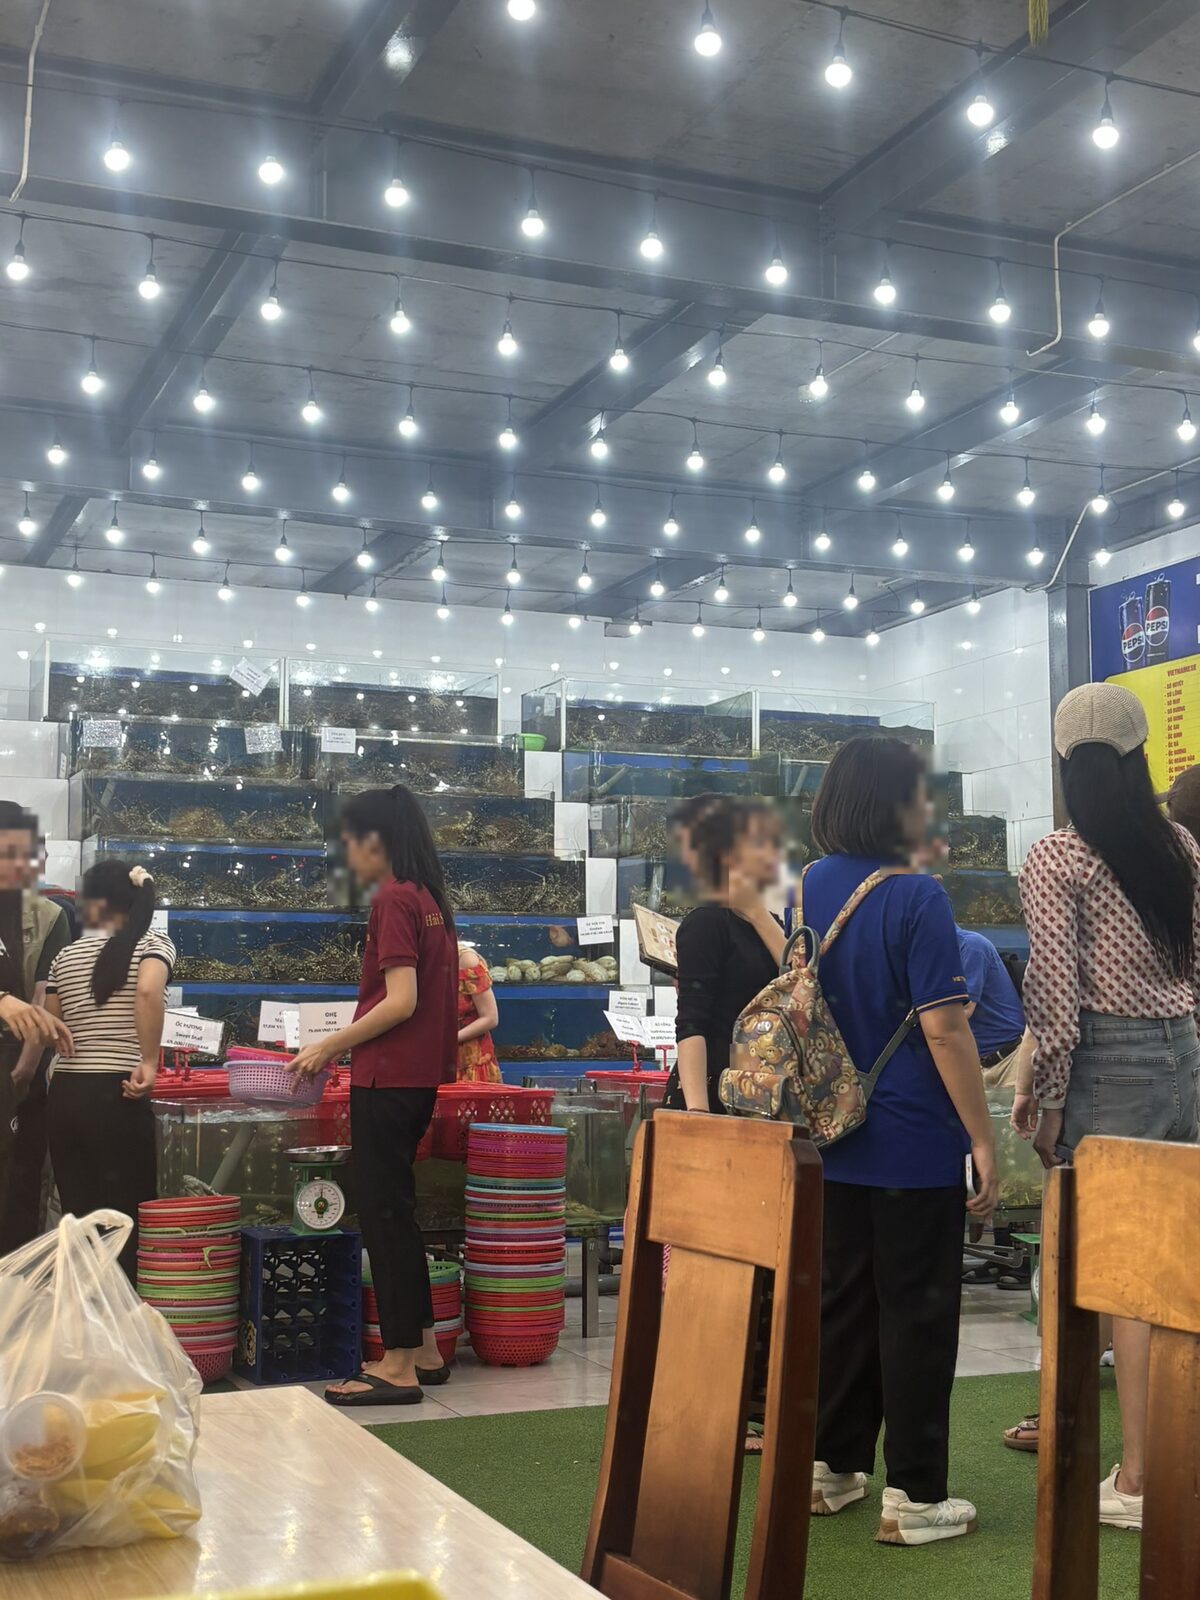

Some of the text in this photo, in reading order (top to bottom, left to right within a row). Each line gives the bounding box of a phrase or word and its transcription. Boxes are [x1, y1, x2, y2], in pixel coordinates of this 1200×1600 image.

[1146, 620, 1169, 632] PEPSI
[1123, 635, 1145, 651] PEPSI
[1167, 664, 1196, 677] VIETNAMESE
